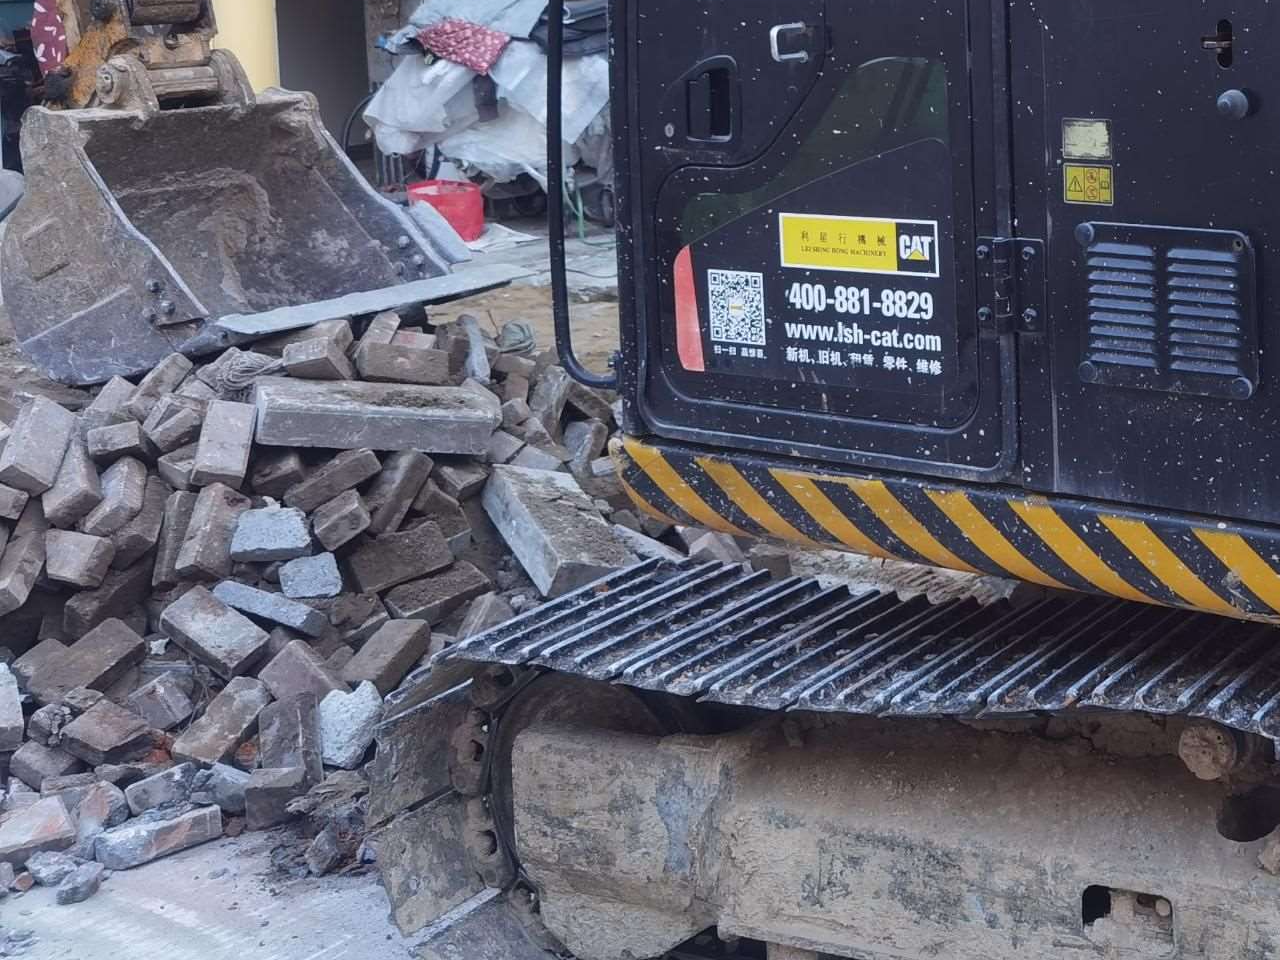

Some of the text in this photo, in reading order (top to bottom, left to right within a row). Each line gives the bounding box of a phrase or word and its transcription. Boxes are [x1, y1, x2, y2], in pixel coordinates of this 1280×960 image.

[899, 234, 932, 260] CAT
[789, 282, 934, 320] 400-881-8829
[784, 321, 942, 352] www.lsh-cat.com
